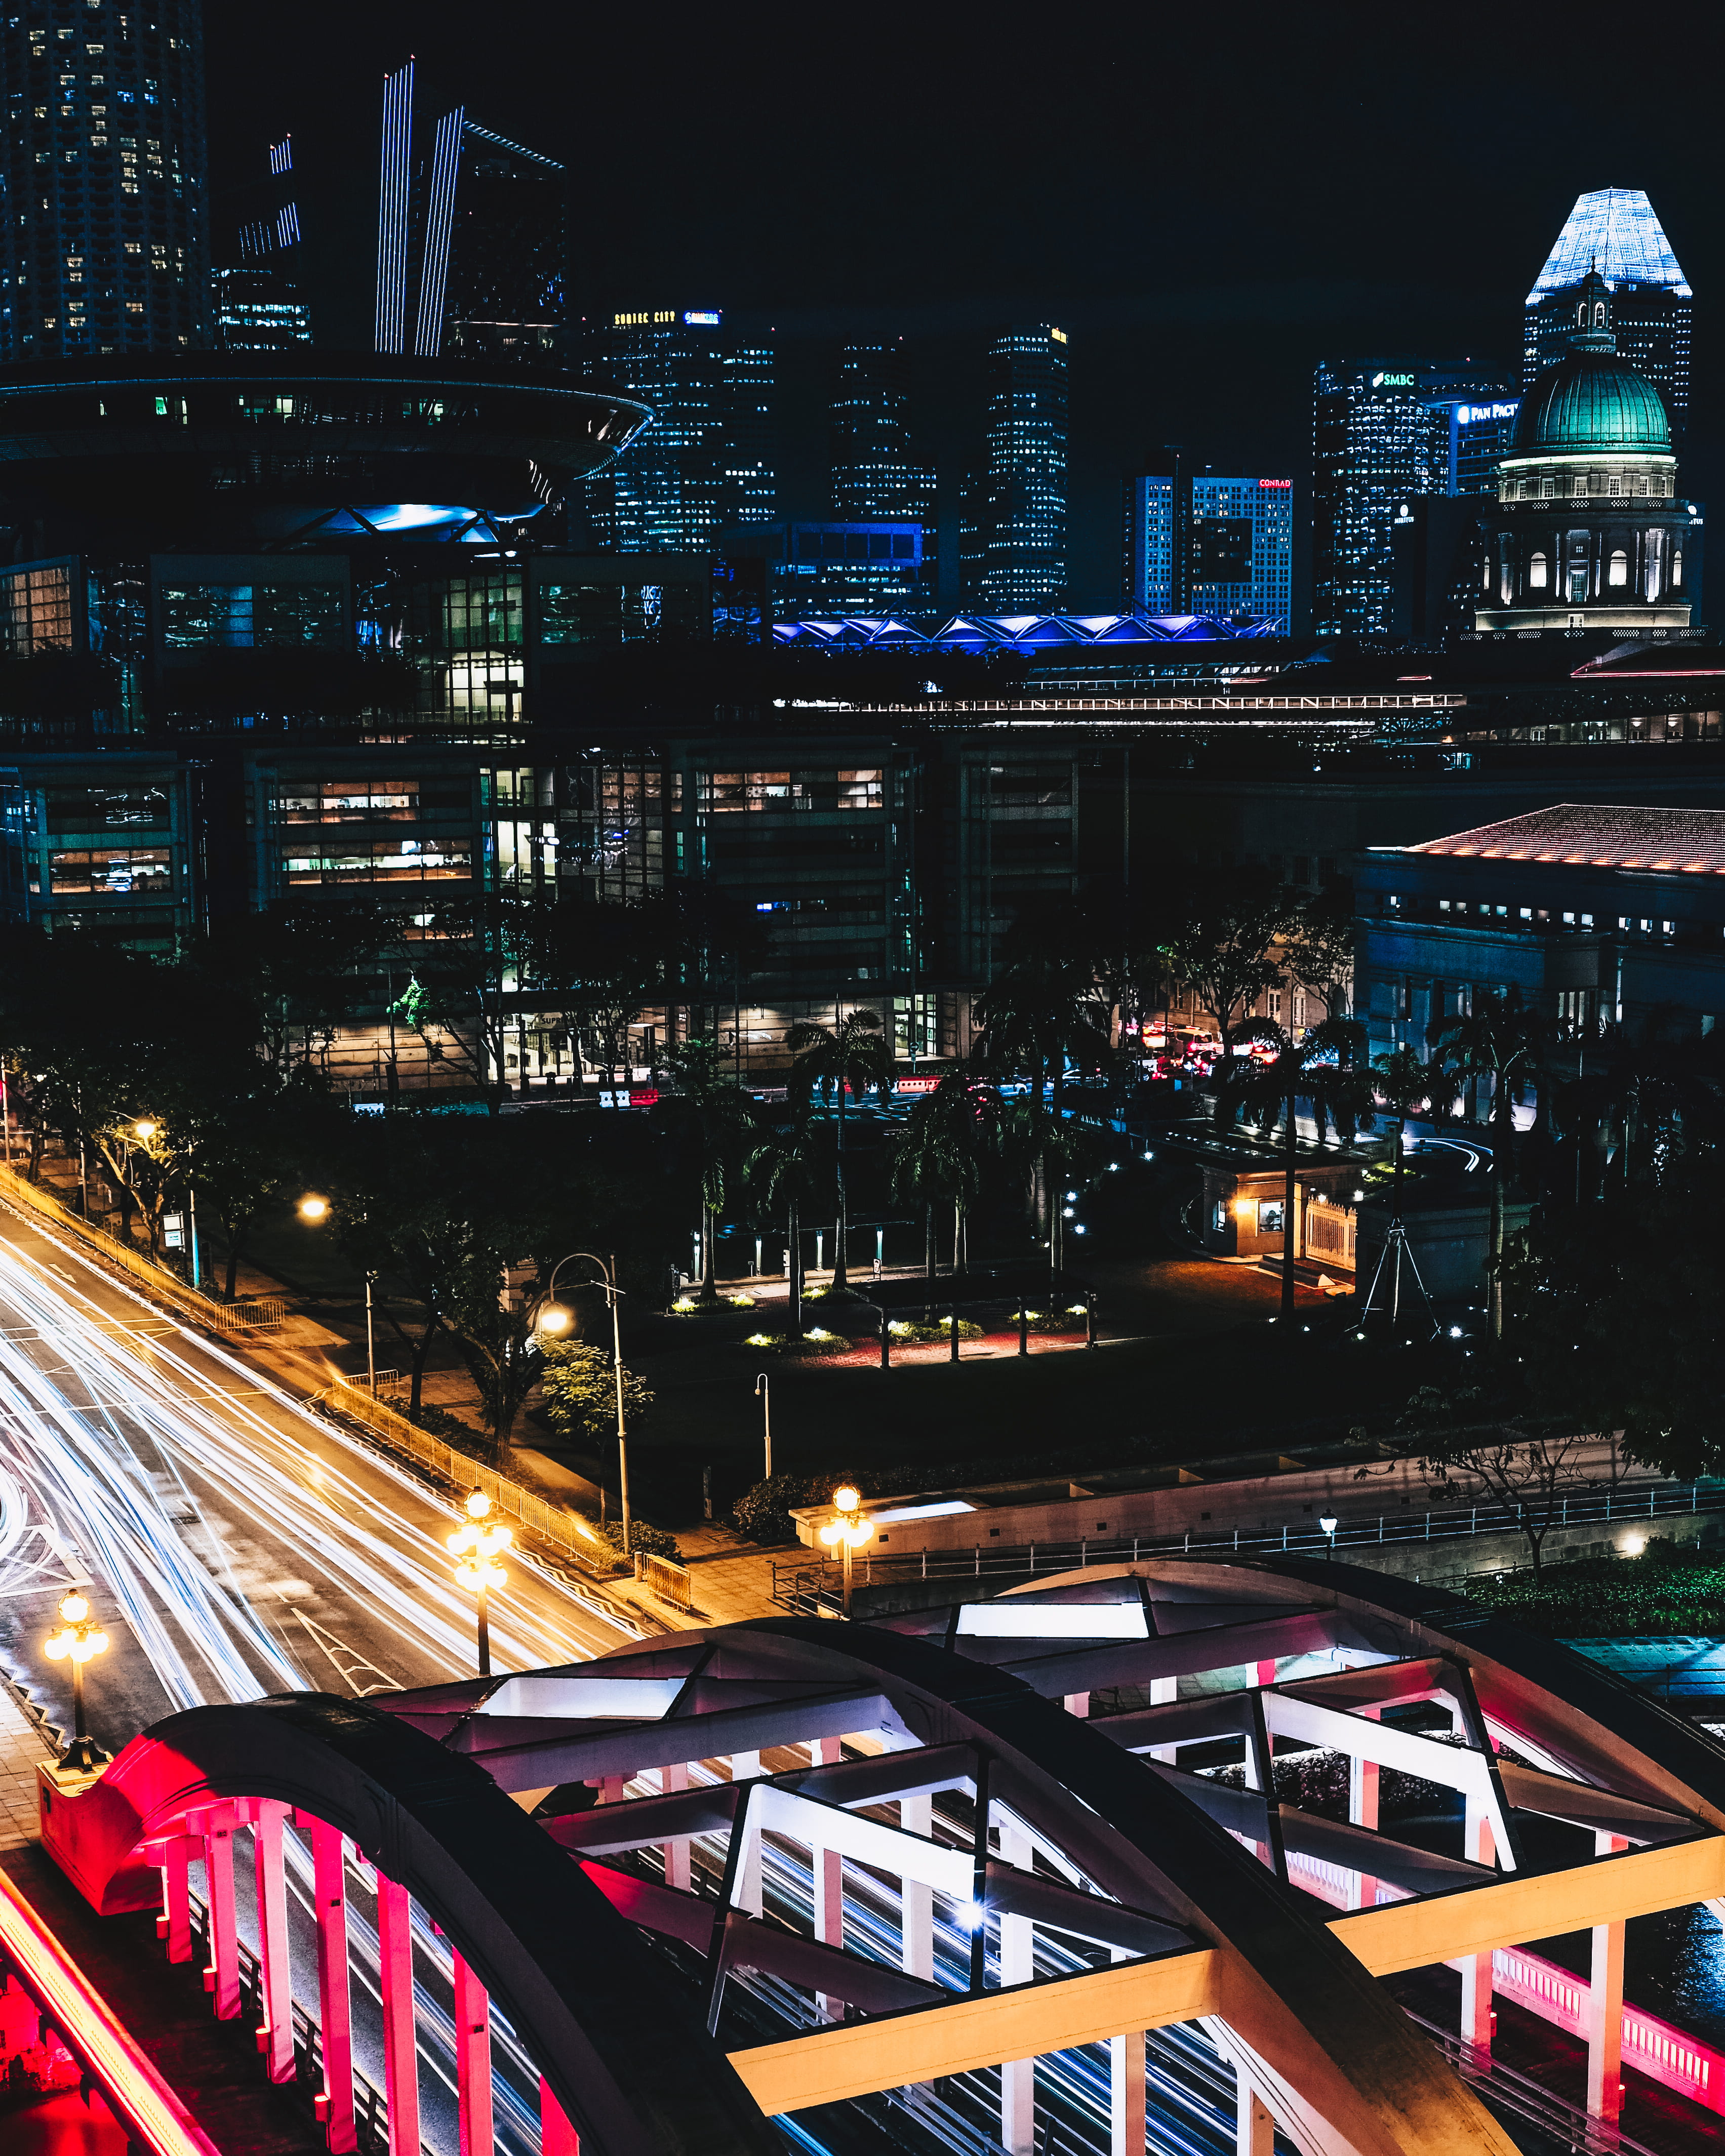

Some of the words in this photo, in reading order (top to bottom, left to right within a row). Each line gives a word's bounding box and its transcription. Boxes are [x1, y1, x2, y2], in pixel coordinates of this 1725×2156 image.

[654, 310, 675, 322] CITY
[1383, 374, 1414, 386] SMBC
[1470, 406, 1491, 421] PAN
